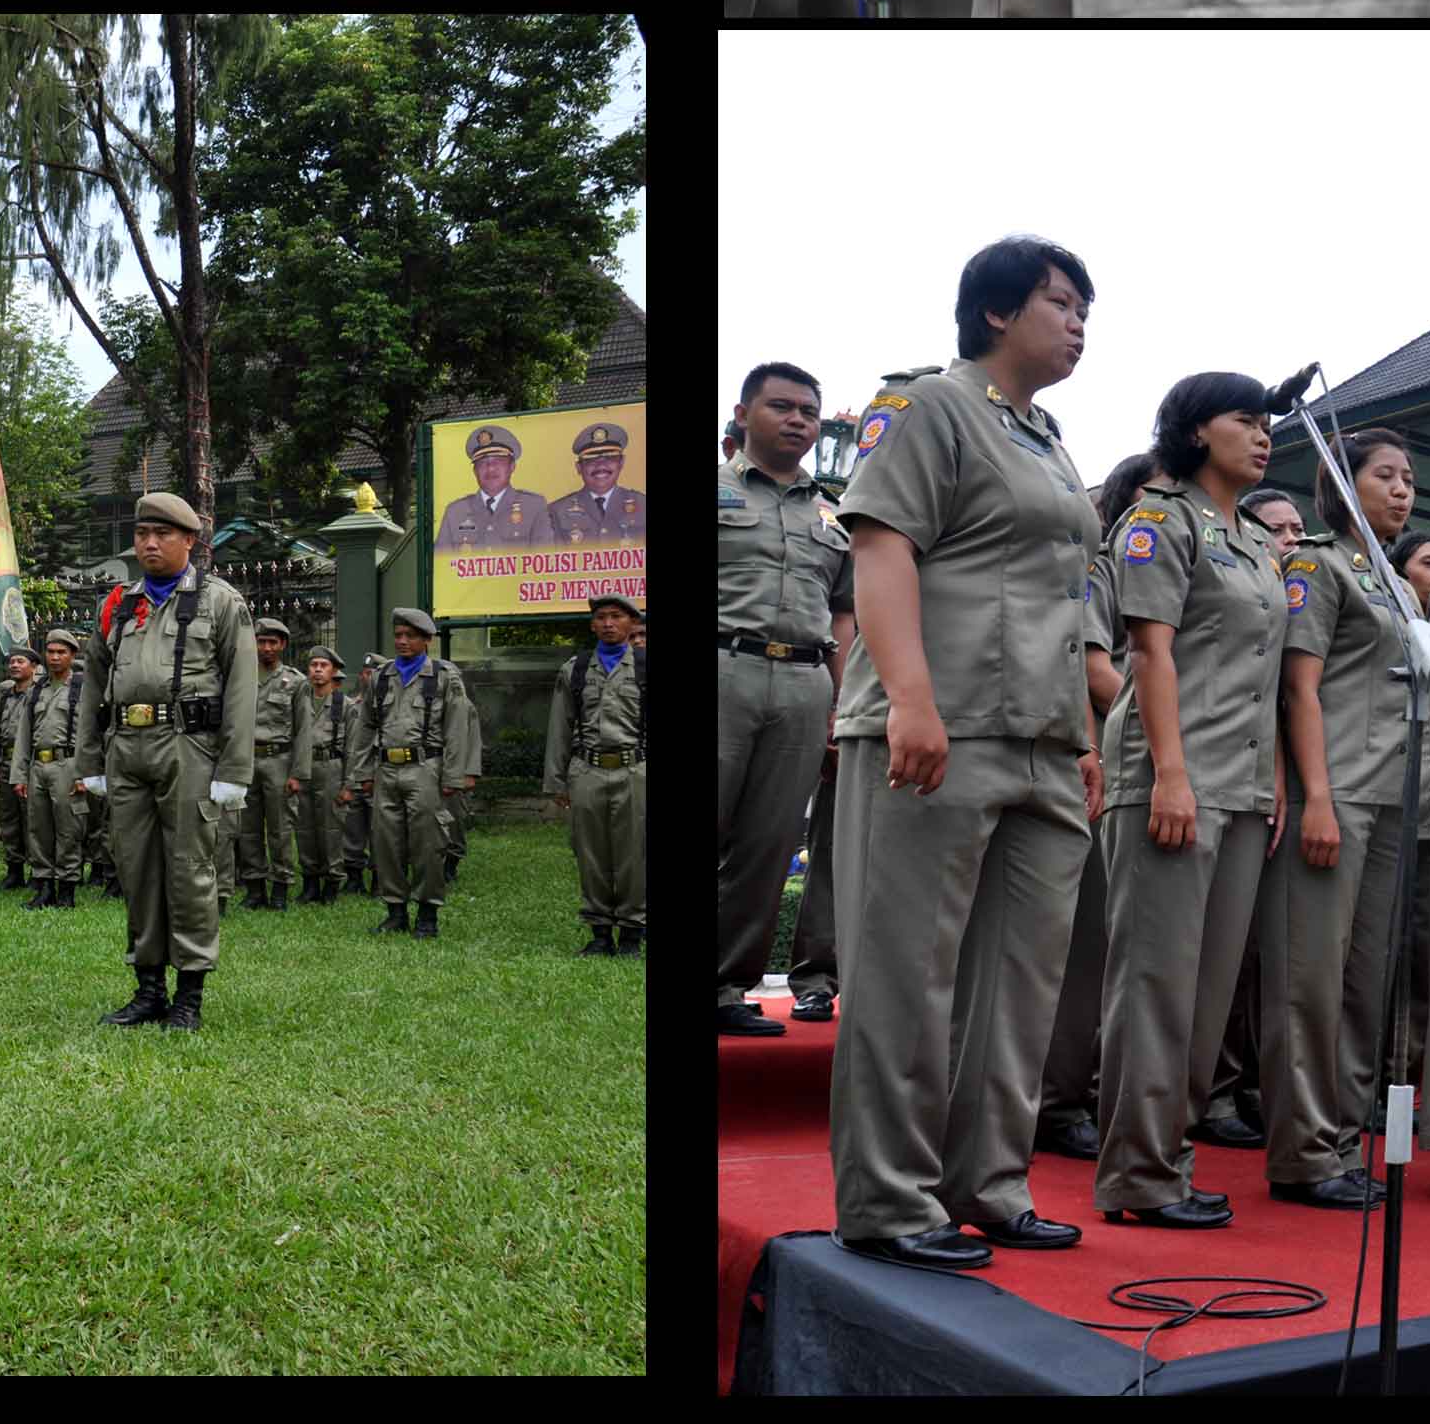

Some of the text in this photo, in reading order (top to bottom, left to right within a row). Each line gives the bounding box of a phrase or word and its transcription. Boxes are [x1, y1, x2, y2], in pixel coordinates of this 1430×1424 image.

[522, 553, 578, 574] POLISI
[582, 549, 645, 571] PAMON
[519, 582, 556, 602] SIAP
